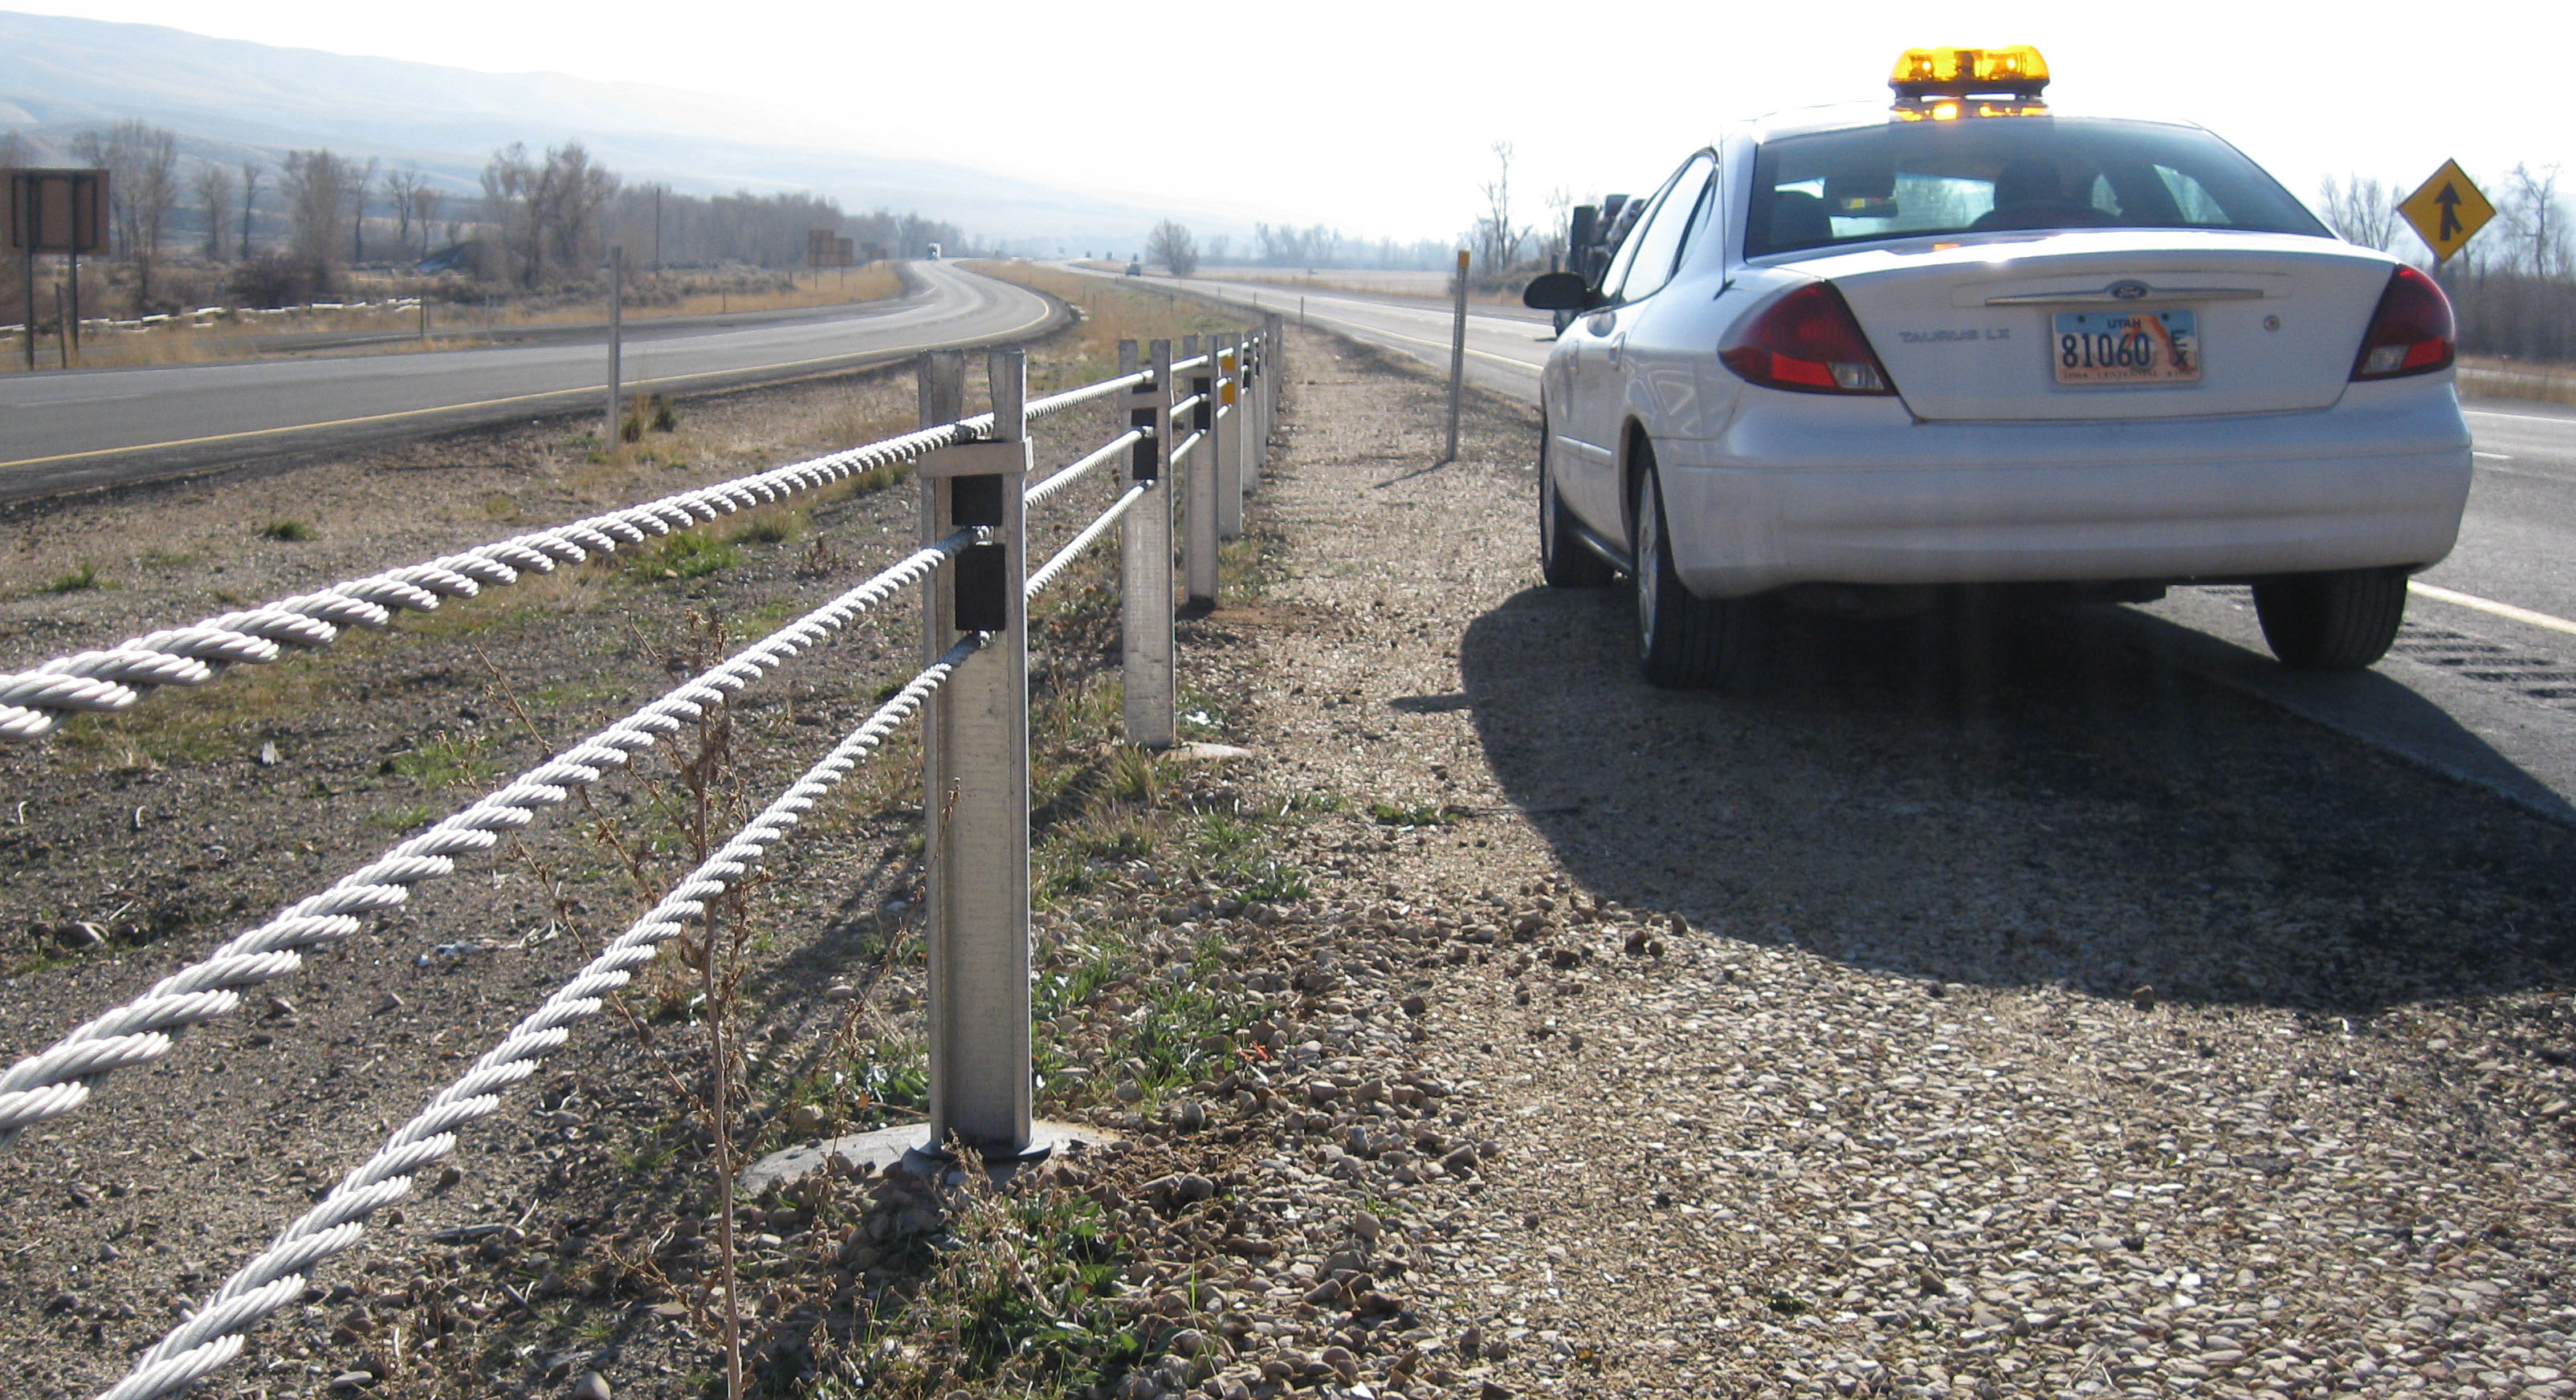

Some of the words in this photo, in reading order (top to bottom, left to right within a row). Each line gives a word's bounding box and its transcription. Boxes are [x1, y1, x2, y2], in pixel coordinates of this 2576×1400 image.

[2107, 319, 2142, 329] UTAH
[1897, 328, 1979, 344] TAURUS
[1985, 328, 2011, 340] LX
[2061, 332, 2152, 368] 81060
